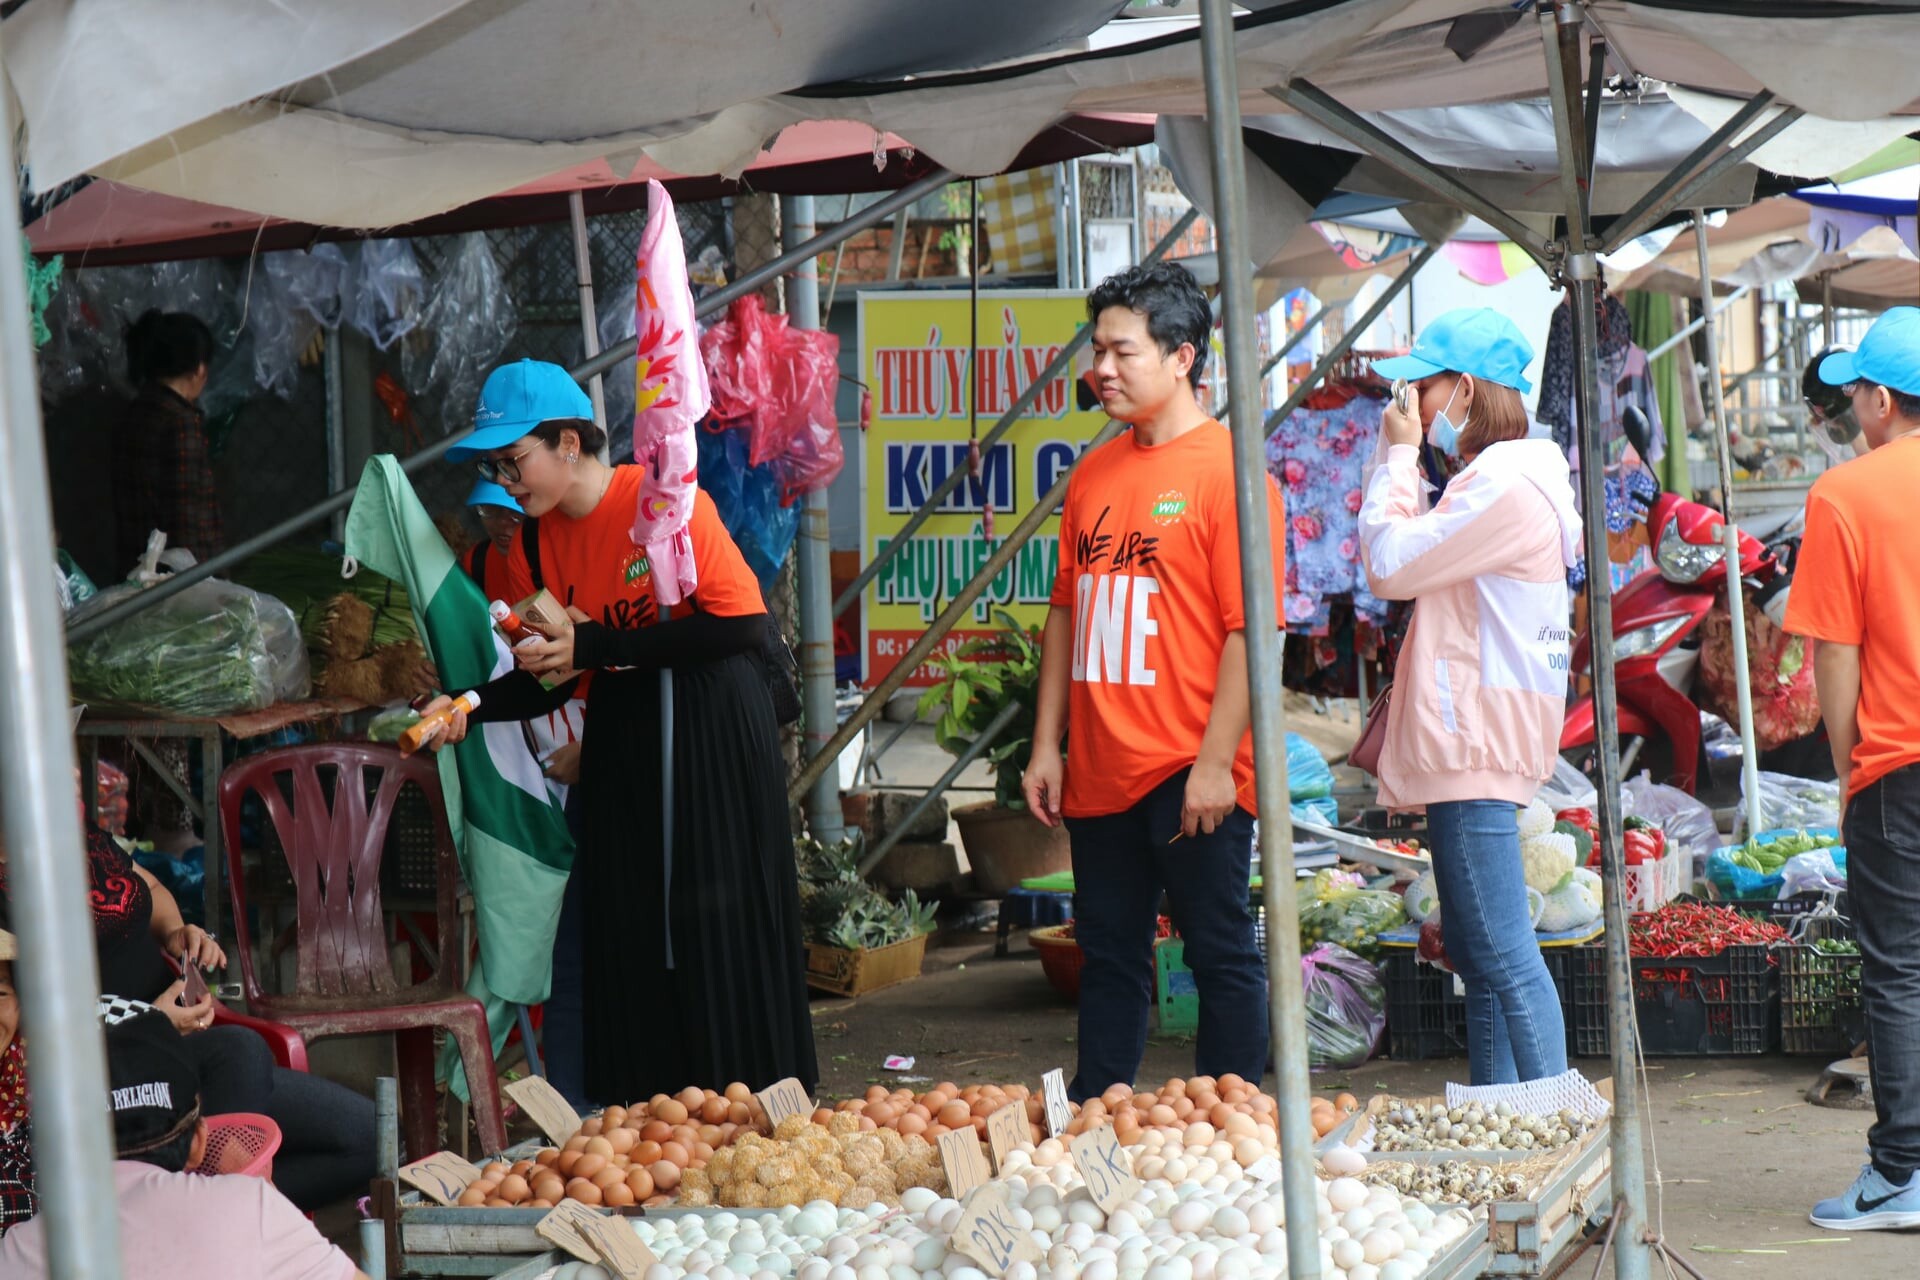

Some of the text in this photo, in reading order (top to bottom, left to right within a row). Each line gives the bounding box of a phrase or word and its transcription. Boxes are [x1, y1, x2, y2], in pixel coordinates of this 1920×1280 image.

[876, 327, 966, 415] THÚY
[888, 444, 1009, 507] KIM
[878, 539, 935, 617] PHỤ
[946, 523, 1009, 617] LIỆU
[1077, 505, 1159, 573] WE ARE
[1071, 573, 1160, 686] ONE
[1546, 629, 1566, 645] you
[112, 1082, 173, 1111] RELIGION
[970, 1204, 1022, 1271] 22K
